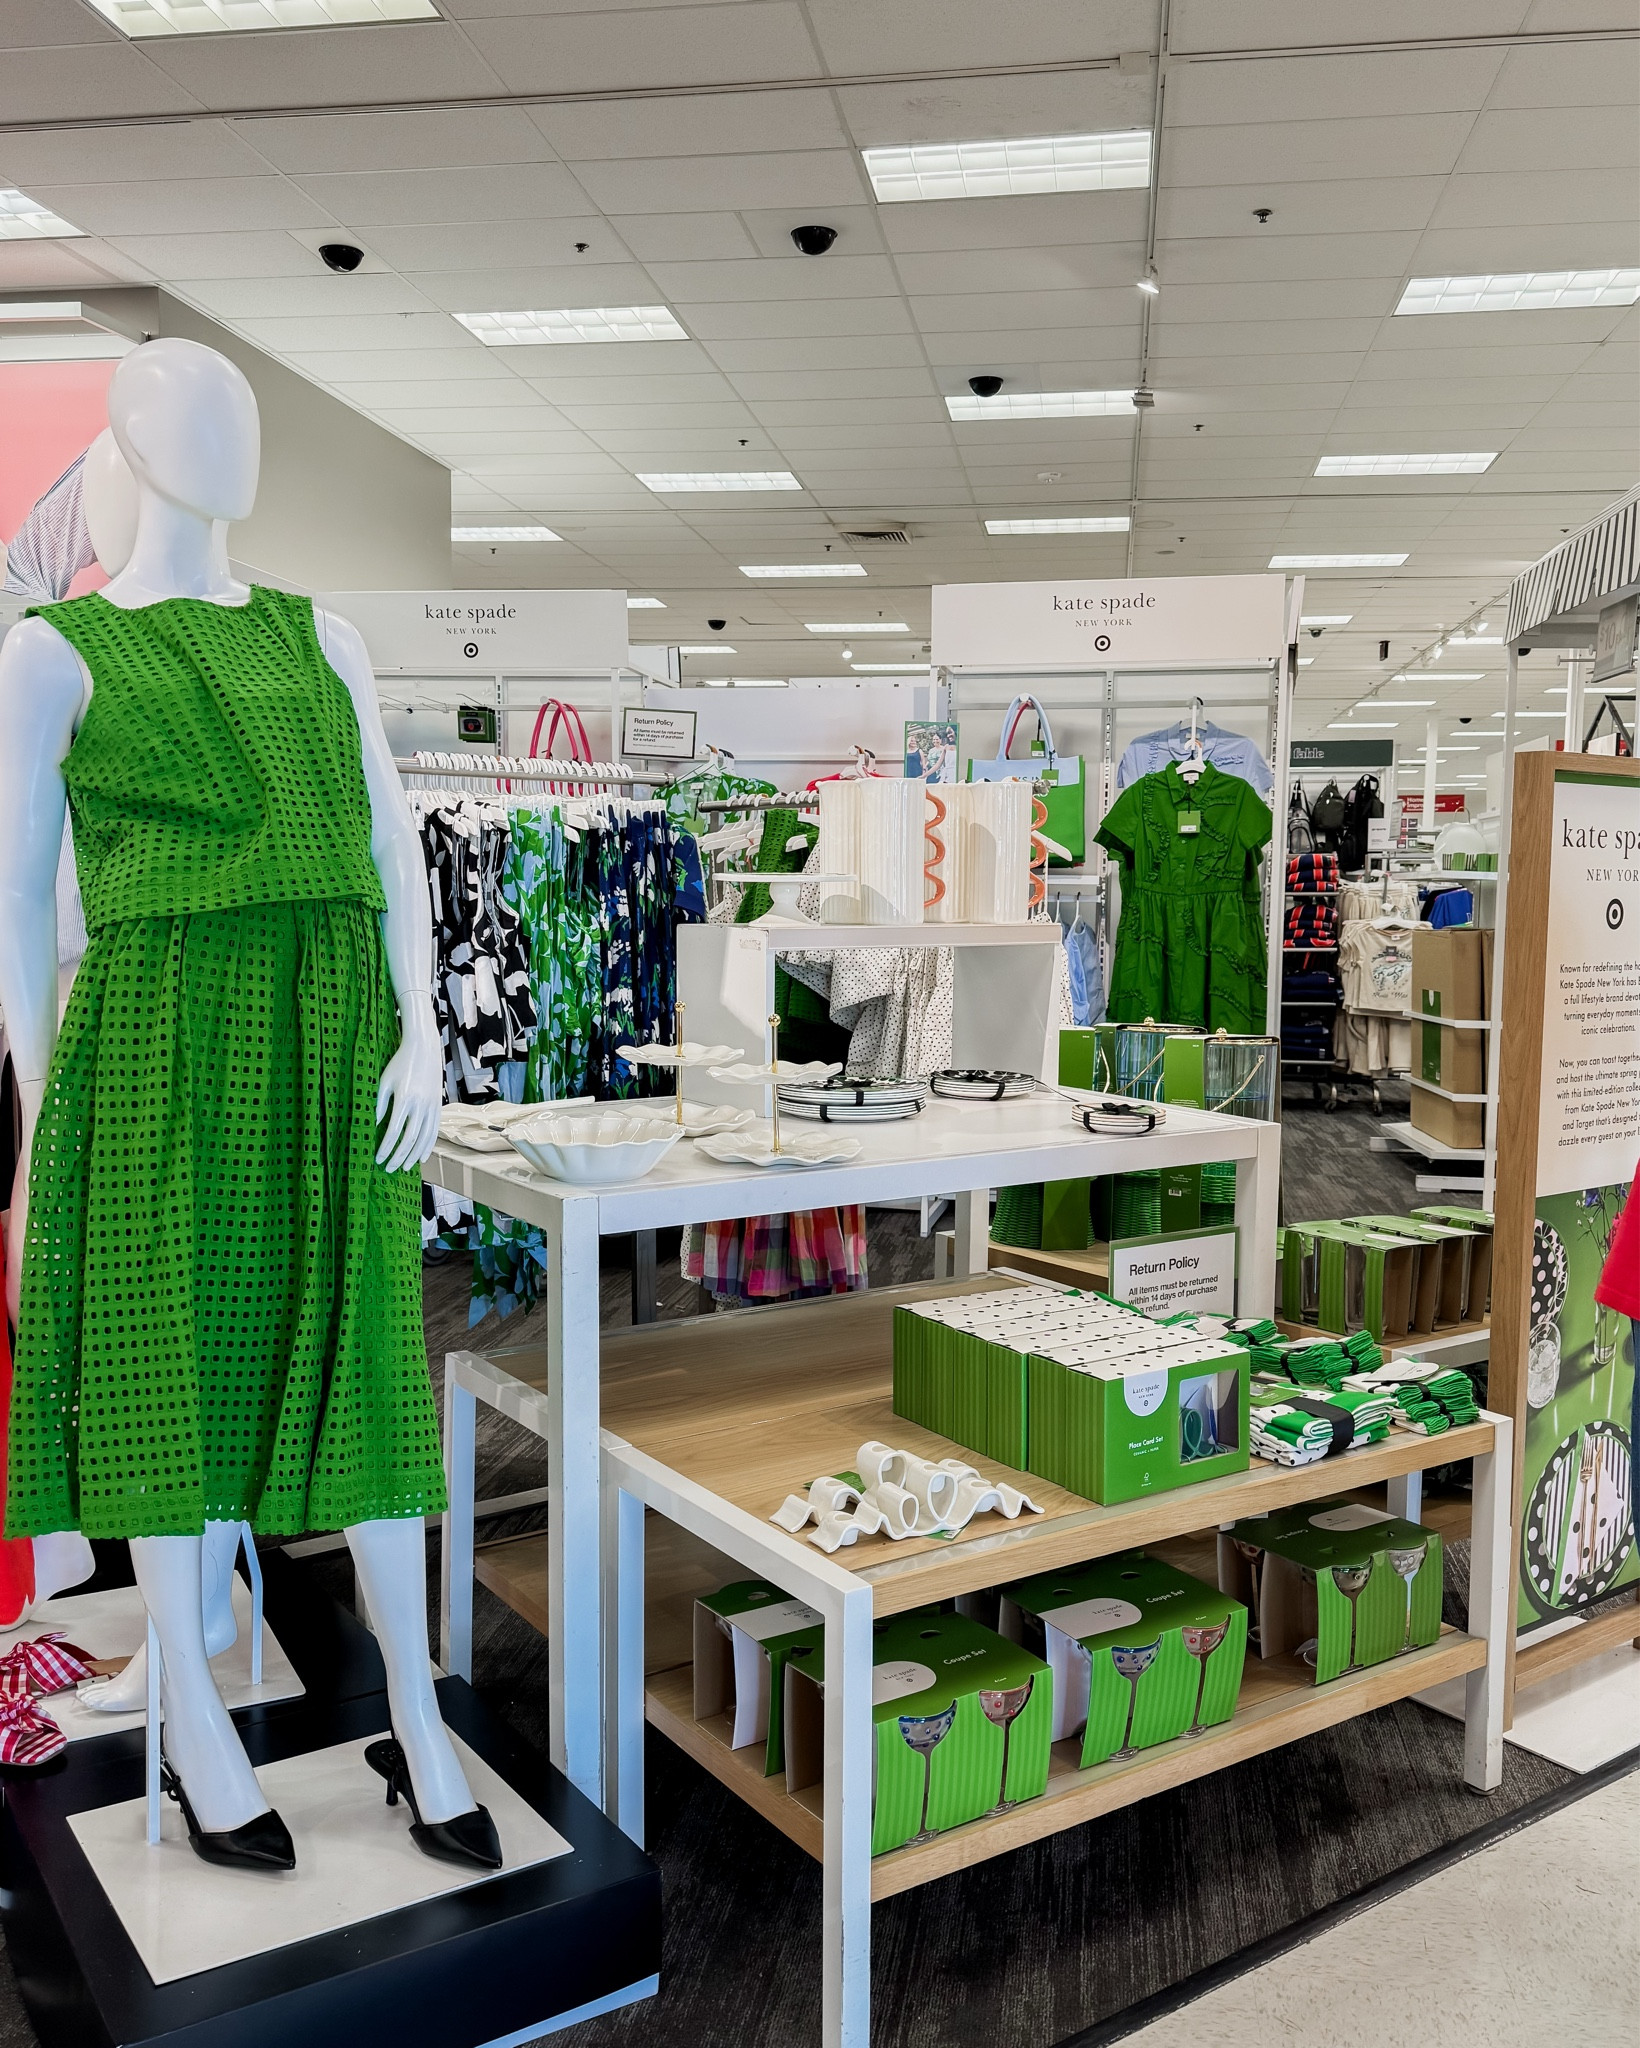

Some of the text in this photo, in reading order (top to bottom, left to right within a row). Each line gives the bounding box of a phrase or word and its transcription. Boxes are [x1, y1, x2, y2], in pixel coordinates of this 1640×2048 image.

[1053, 592, 1156, 614] kate spade
[425, 604, 516, 623] kate spade
[1075, 618, 1133, 627] NEW YORK
[446, 627, 497, 635] NEW YORK
[634, 717, 674, 727] Return Policy
[1293, 747, 1325, 759] fable
[1562, 818, 1640, 860] kate sp
[1586, 868, 1613, 882] NEW
[1560, 964, 1581, 973] Known
[1582, 962, 1592, 973] for
[1593, 961, 1623, 974] redefining
[1624, 961, 1633, 971] the
[1560, 979, 1574, 989] Kate
[1576, 977, 1596, 991] Spade
[1597, 978, 1611, 988] New
[1612, 977, 1626, 987] York
[1626, 975, 1637, 986] has
[1564, 997, 1569, 1005] a
[1570, 994, 1580, 1005] full
[1581, 993, 1605, 1006] lifestyle
[1606, 991, 1624, 1003] brand
[1564, 1010, 1586, 1023] turning
[1587, 1008, 1615, 1022] everyday
[1581, 1022, 1636, 1035] iconic celebrations.
[1559, 1059, 1575, 1069] Now,
[1576, 1059, 1588, 1069] you
[1589, 1058, 1600, 1066] can
[1601, 1055, 1617, 1065] toast
[1556, 1073, 1569, 1085] and
[1570, 1072, 1583, 1083] host
[1584, 1071, 1594, 1082] the
[1595, 1070, 1618, 1081] ultimate
[1620, 1068, 1638, 1079] spring
[1557, 1089, 1570, 1100] with
[1571, 1087, 1582, 1098] this
[1583, 1084, 1624, 1097] limited-edition
[1564, 1104, 1579, 1115] from
[1580, 1103, 1595, 1113] Kate
[1596, 1100, 1615, 1114] Spade
[1616, 1099, 1630, 1109] New
[1562, 1119, 1574, 1131] and
[1575, 1119, 1595, 1130] Target
[1612, 1111, 1638, 1125] designed
[1558, 1135, 1579, 1147] dazzle
[1580, 1135, 1597, 1145] every
[1598, 1131, 1614, 1144] guest
[1615, 1131, 1623, 1139] on
[1623, 1129, 1636, 1140] your
[1129, 1256, 1200, 1276] Return Policy
[1128, 1274, 1219, 1296] All items must be returned
[1128, 1285, 1218, 1307] within 14 days of purchase
[1145, 1302, 1170, 1313] refund.
[1128, 1435, 1164, 1450] Place Card Set
[943, 1648, 987, 1665] Coupe Set
